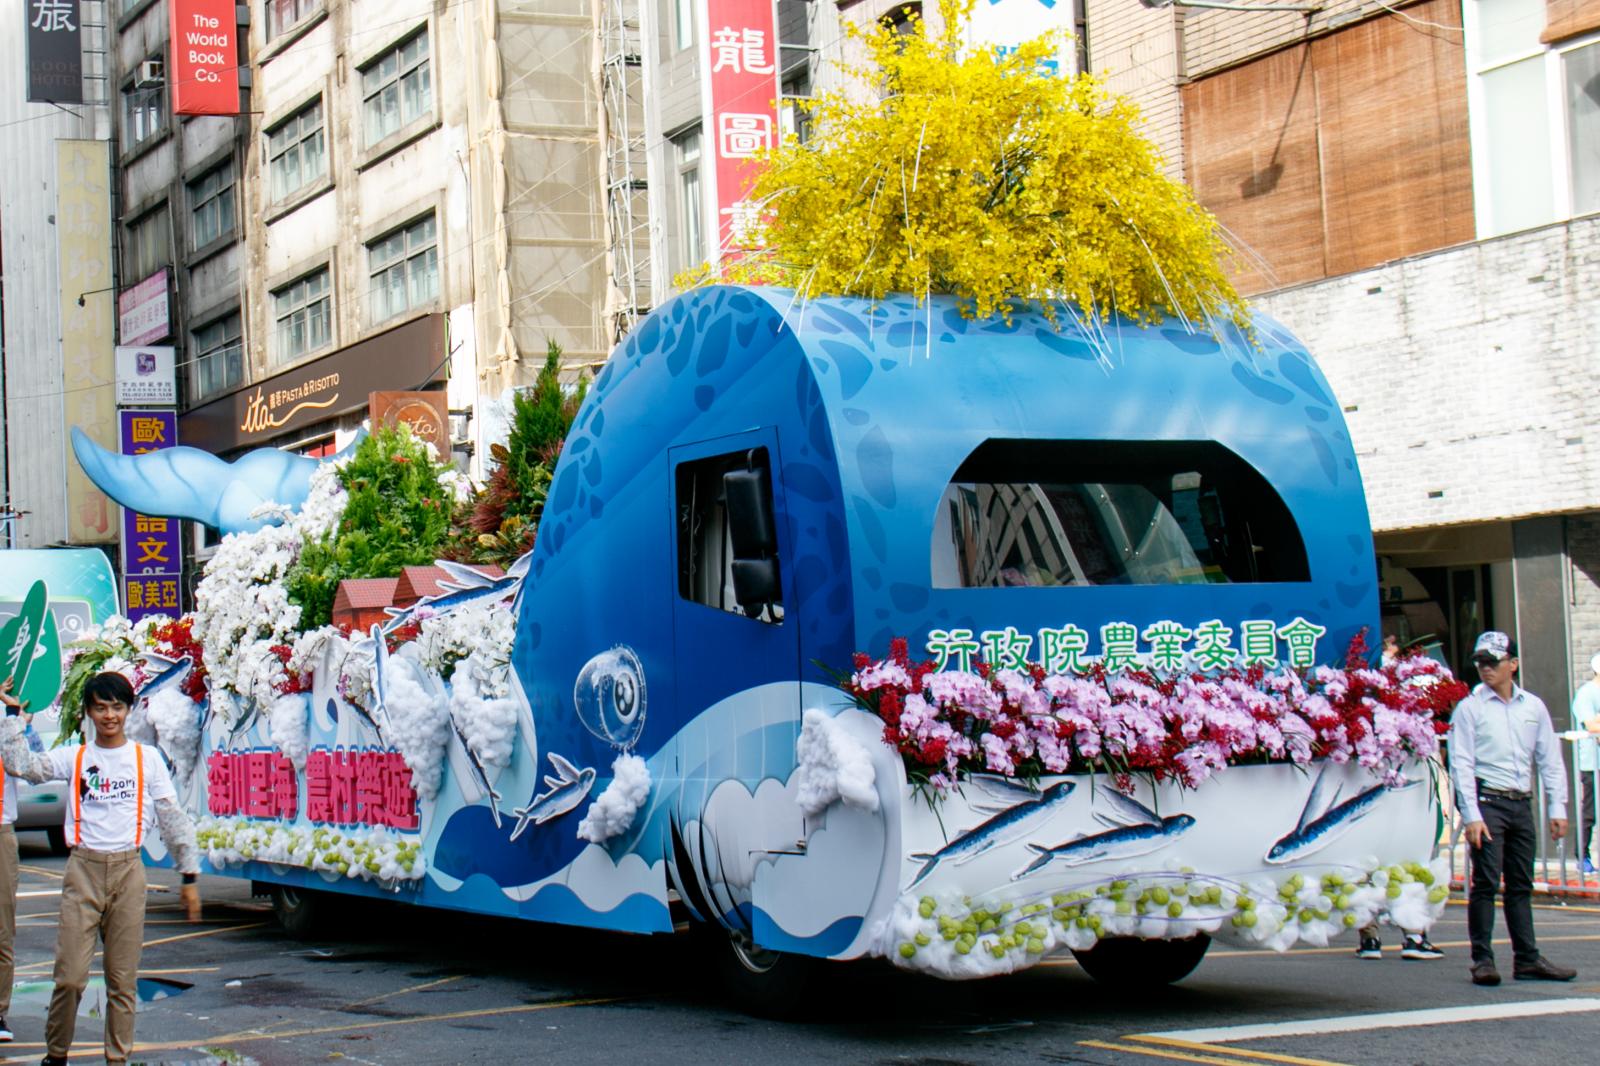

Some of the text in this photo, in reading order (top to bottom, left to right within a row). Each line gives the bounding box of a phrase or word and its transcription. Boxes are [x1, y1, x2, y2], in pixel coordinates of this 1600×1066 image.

[31, 1, 77, 32] 旅
[192, 14, 219, 28] The
[186, 32, 228, 47] World
[188, 50, 225, 65] Book
[194, 68, 222, 83] Co.
[127, 581, 178, 609] 歐美亞
[925, 616, 1327, 676] 行政院農業委員會
